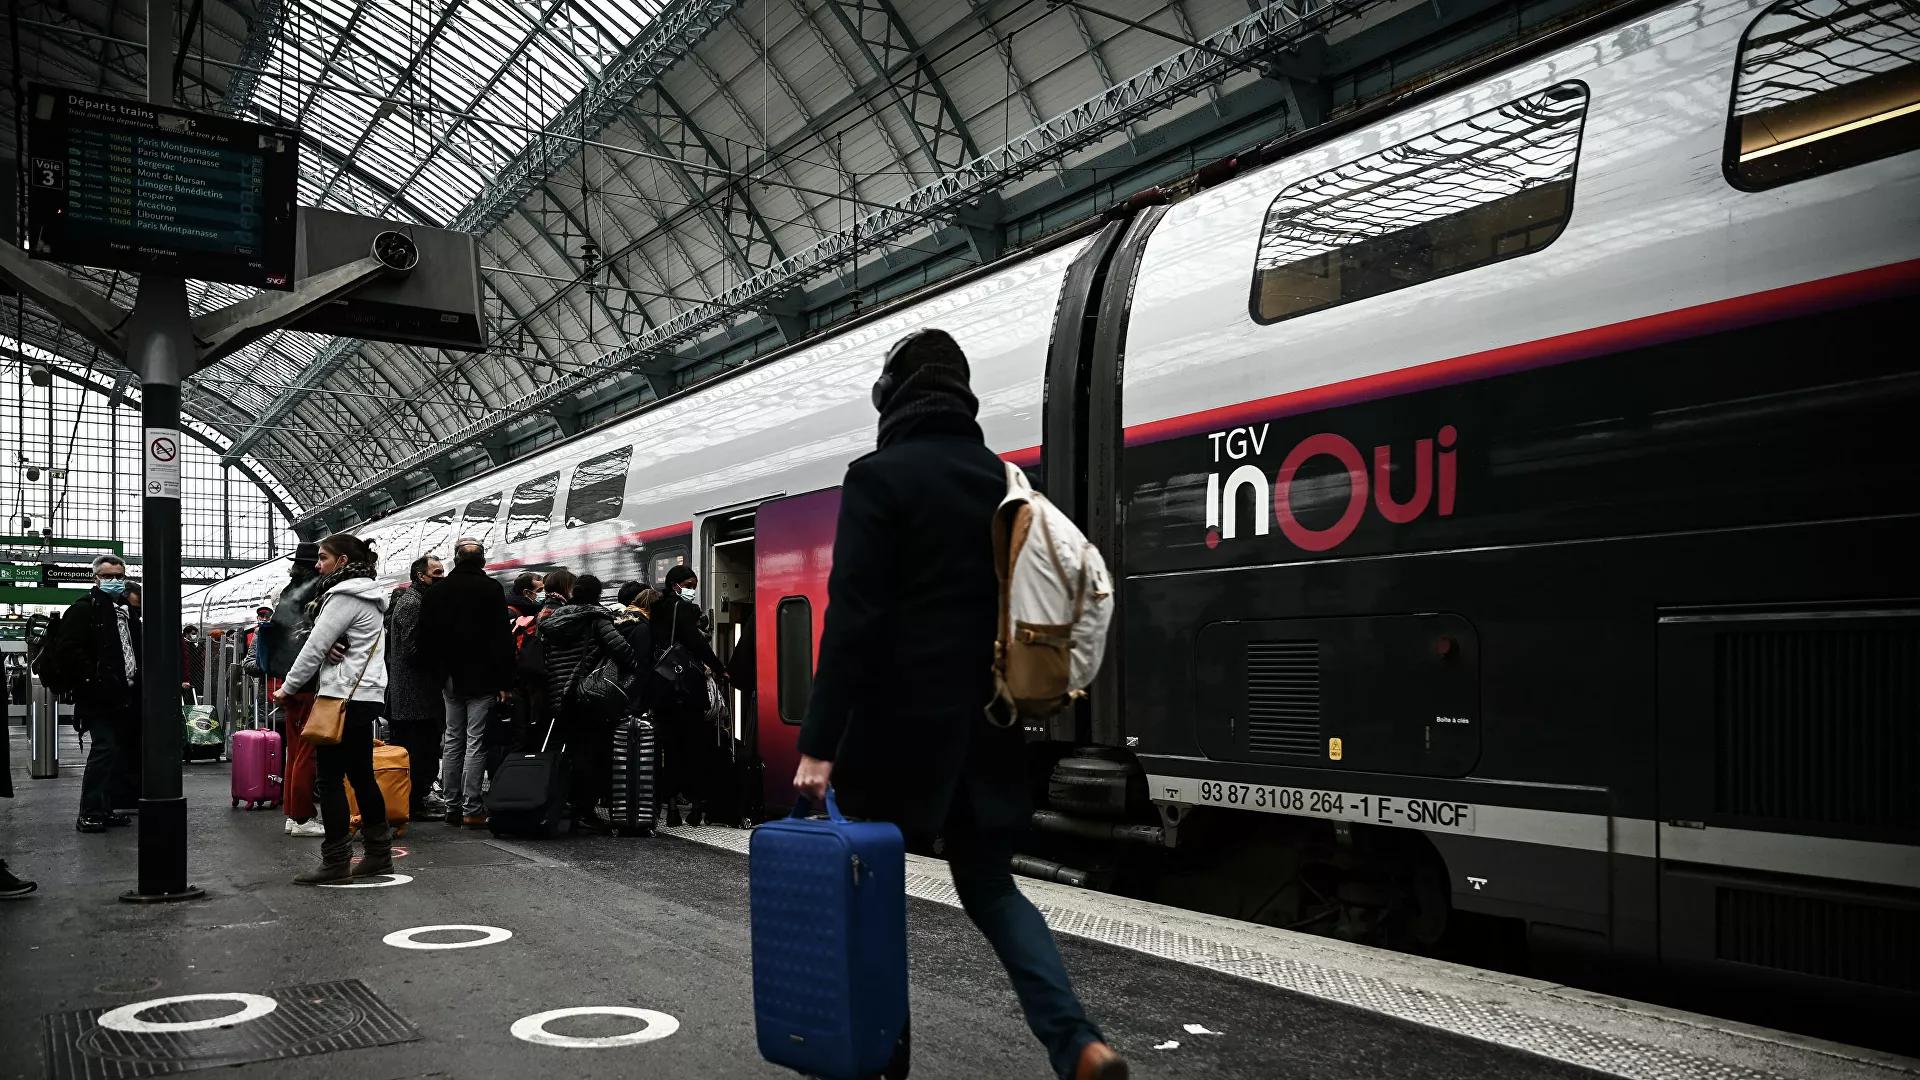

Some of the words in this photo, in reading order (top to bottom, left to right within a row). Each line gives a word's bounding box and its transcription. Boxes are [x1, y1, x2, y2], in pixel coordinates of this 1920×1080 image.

[68, 95, 116, 112] Départs
[120, 105, 154, 119] trains
[138, 136, 159, 148] Paris
[160, 140, 220, 158] Montparnasse
[36, 159, 61, 171] Voie
[137, 158, 175, 172] Bergerac
[138, 147, 159, 158] Paris
[160, 151, 220, 168] Montparnasse
[42, 169, 55, 187] 3
[137, 168, 161, 180] Mont
[162, 173, 174, 182] de
[175, 174, 206, 186] Marsan
[137, 178, 173, 193] Limoges
[175, 184, 223, 199] Bénédictins
[137, 189, 174, 202] Lesparre
[137, 199, 177, 212] Arcachon
[137, 209, 175, 223] Libourne
[137, 220, 159, 231] Paris
[159, 223, 218, 239] Montparnasse
[110, 241, 131, 251] heure
[138, 246, 177, 257] destination
[1207, 422, 1270, 463] TGV
[16, 568, 39, 576] Sortie
[1200, 781, 1223, 802] 93
[1227, 784, 1250, 805] 87
[1255, 787, 1304, 811] 3108
[1310, 791, 1345, 814] 264
